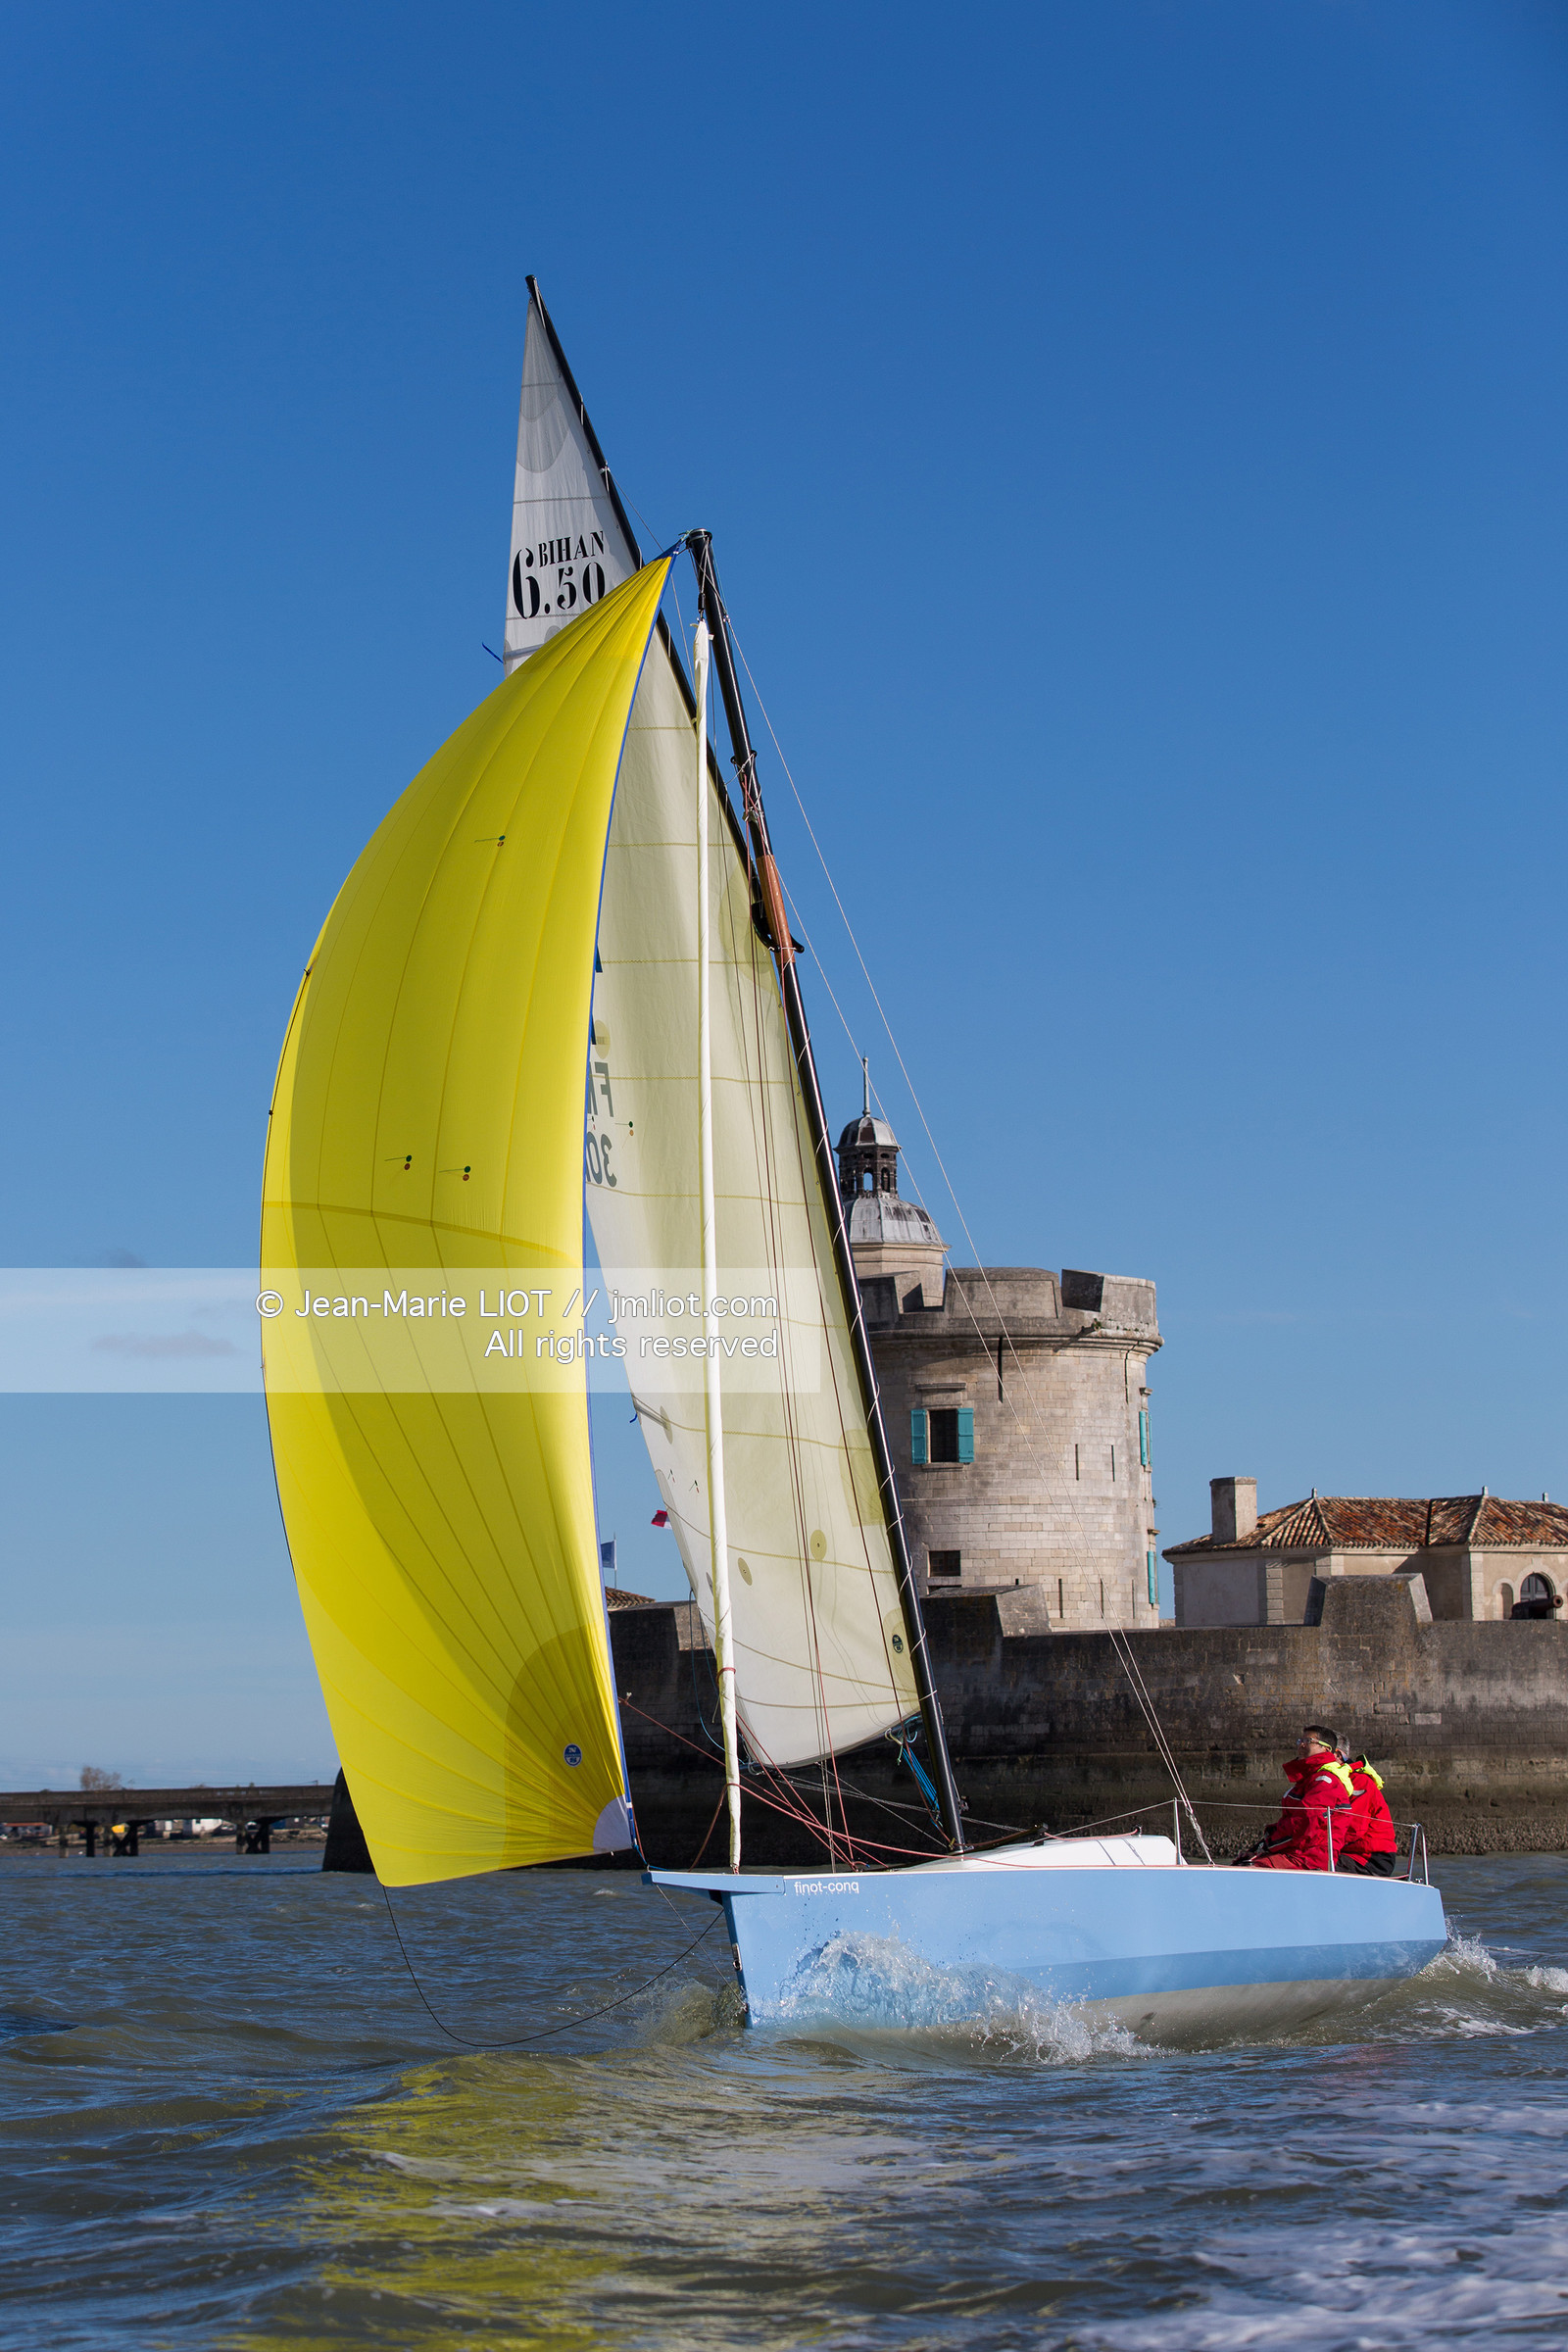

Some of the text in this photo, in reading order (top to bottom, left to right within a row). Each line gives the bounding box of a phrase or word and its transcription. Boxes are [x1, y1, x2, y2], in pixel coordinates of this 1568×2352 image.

[538, 531, 604, 567] BIHAN
[513, 548, 605, 619] 6.50
[794, 1881, 859, 1893] finot-conq
